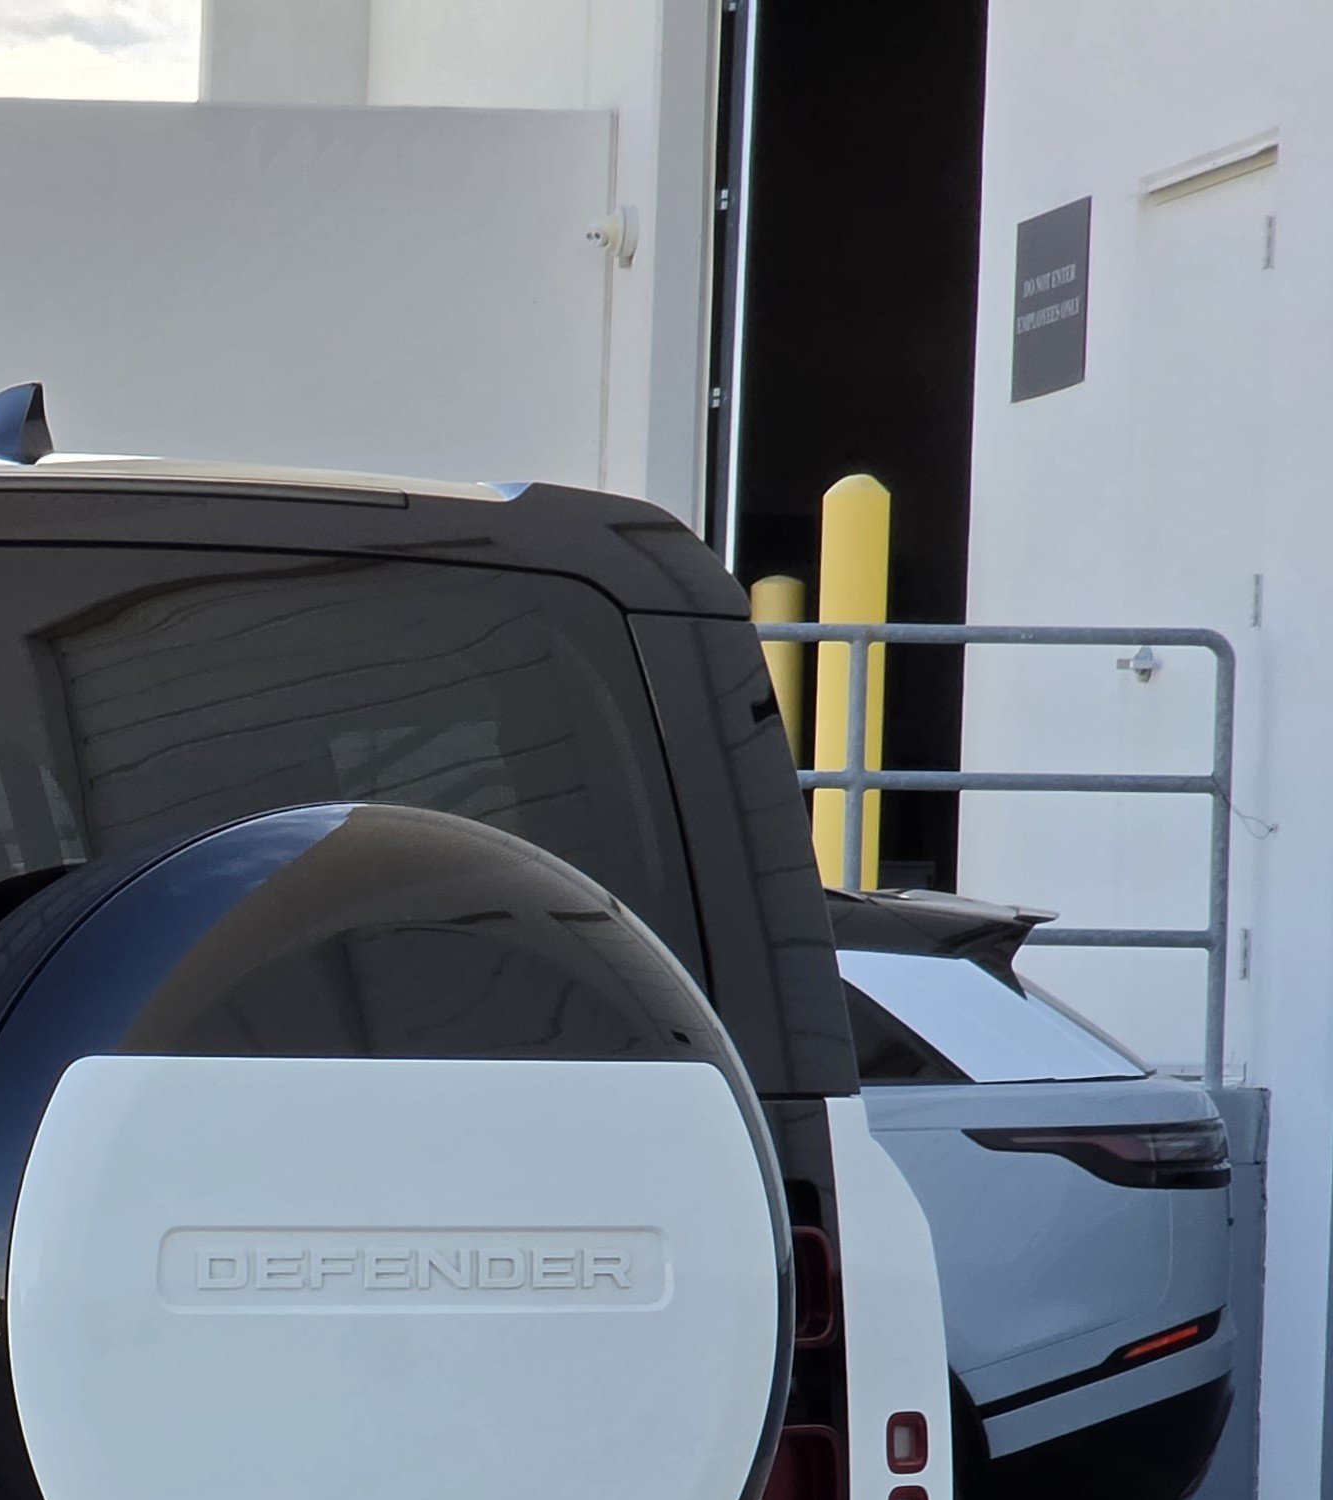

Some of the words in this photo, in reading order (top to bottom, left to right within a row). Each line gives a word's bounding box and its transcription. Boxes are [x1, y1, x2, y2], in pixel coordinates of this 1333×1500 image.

[1051, 264, 1076, 289] ENTER
[1017, 303, 1060, 333] EMPLOYEES
[194, 1247, 634, 1291] DEFENDER
